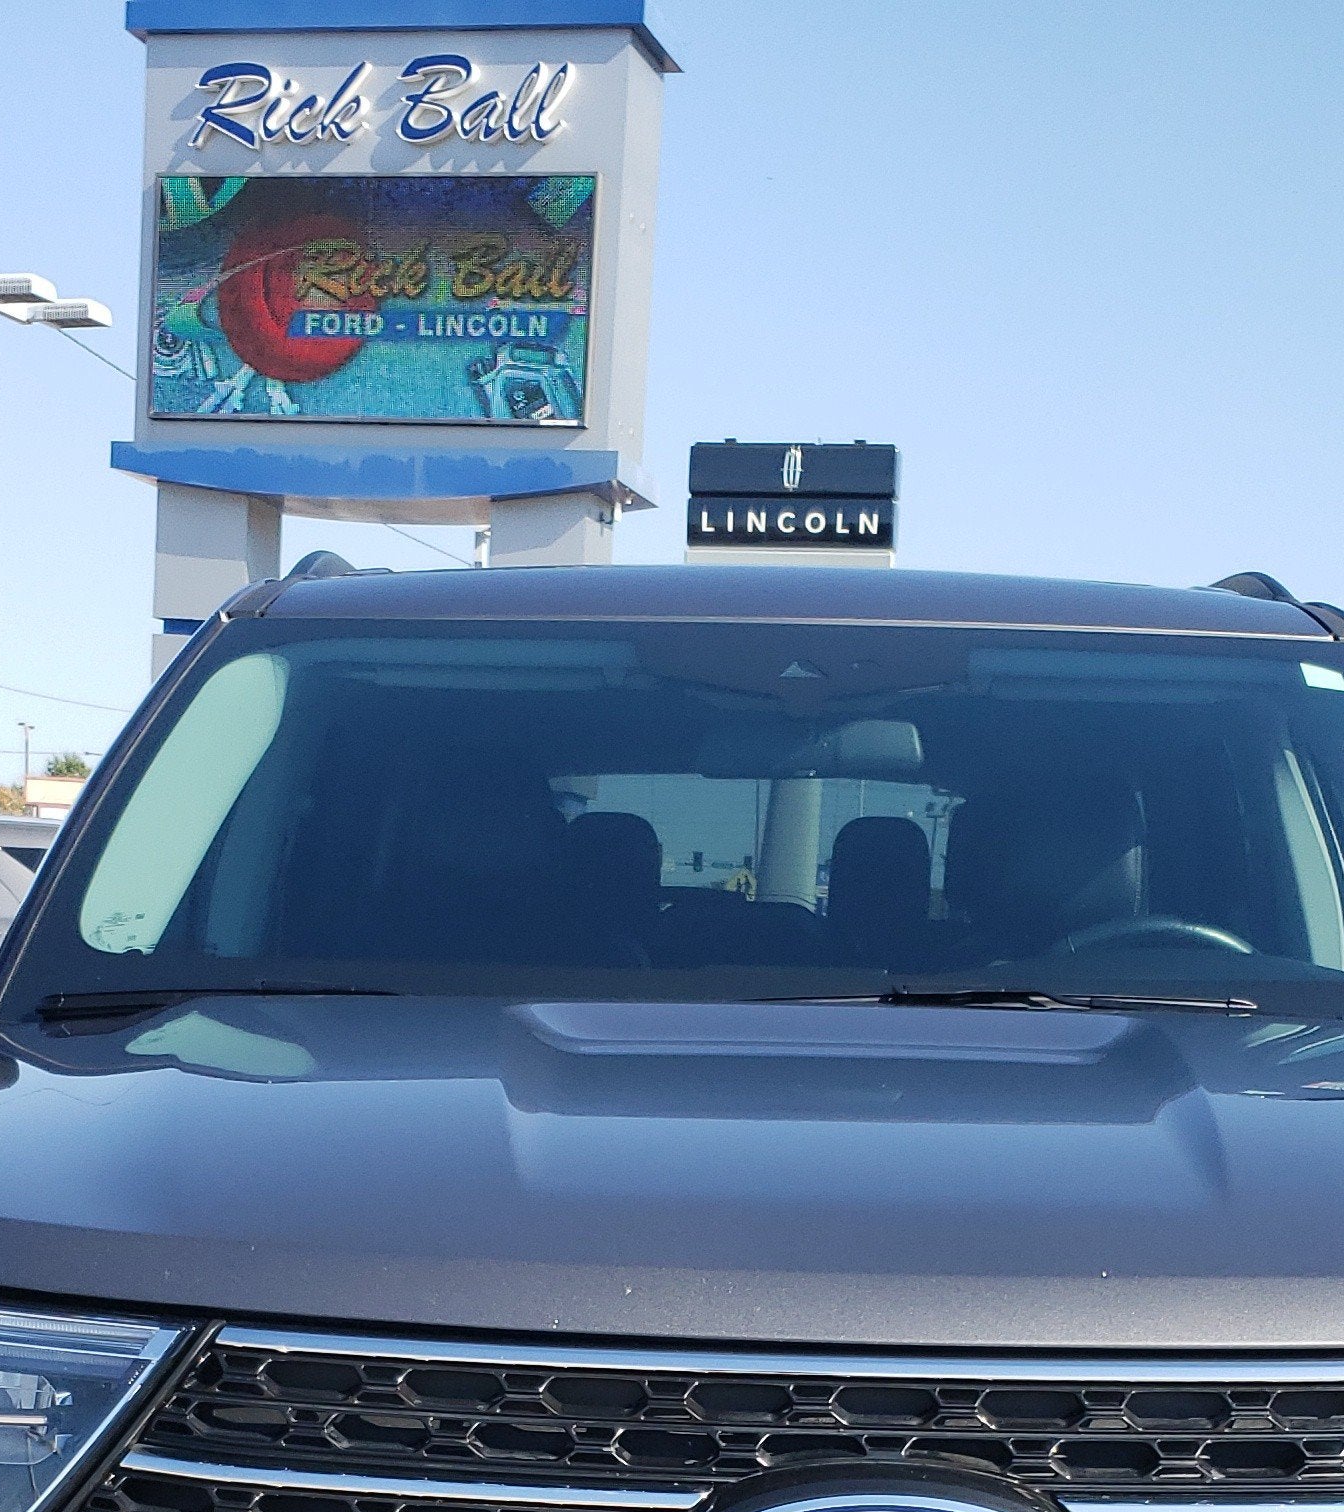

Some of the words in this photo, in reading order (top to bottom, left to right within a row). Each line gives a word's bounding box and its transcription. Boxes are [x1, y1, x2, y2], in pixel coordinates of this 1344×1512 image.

[188, 60, 372, 149] Rick
[396, 54, 574, 144] Ball
[296, 238, 431, 303] Rick
[451, 234, 578, 299] Ball
[305, 313, 384, 335] FORD
[418, 313, 548, 337] LINCOLN
[701, 511, 879, 535] LINCOLN
